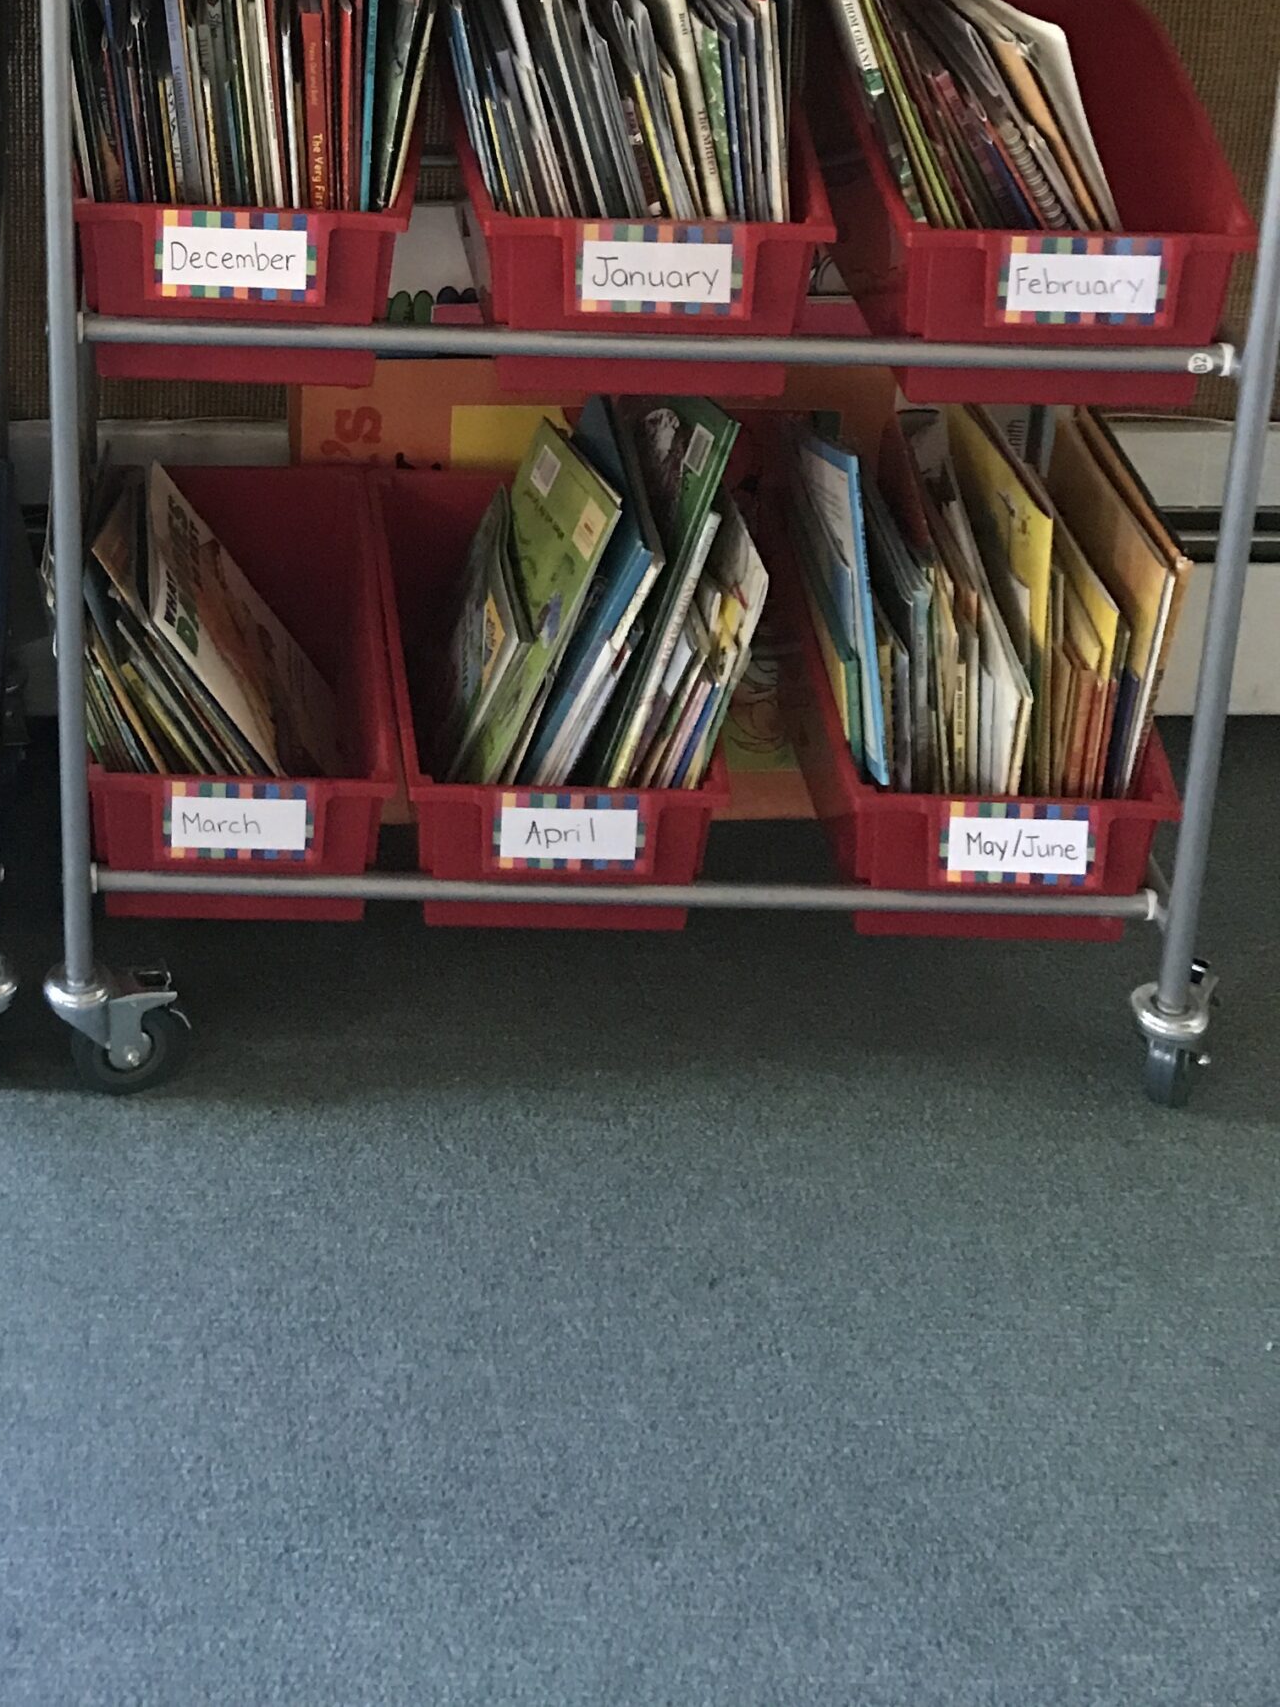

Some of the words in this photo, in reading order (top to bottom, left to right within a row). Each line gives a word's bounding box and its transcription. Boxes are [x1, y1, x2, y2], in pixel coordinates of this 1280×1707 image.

[310, 133, 324, 154] The
[311, 156, 326, 181] Very
[170, 241, 296, 272] December
[592, 255, 720, 290] January
[1015, 266, 1145, 303] February
[181, 812, 262, 836] March
[525, 817, 596, 846] April
[966, 828, 1079, 862] May/June
